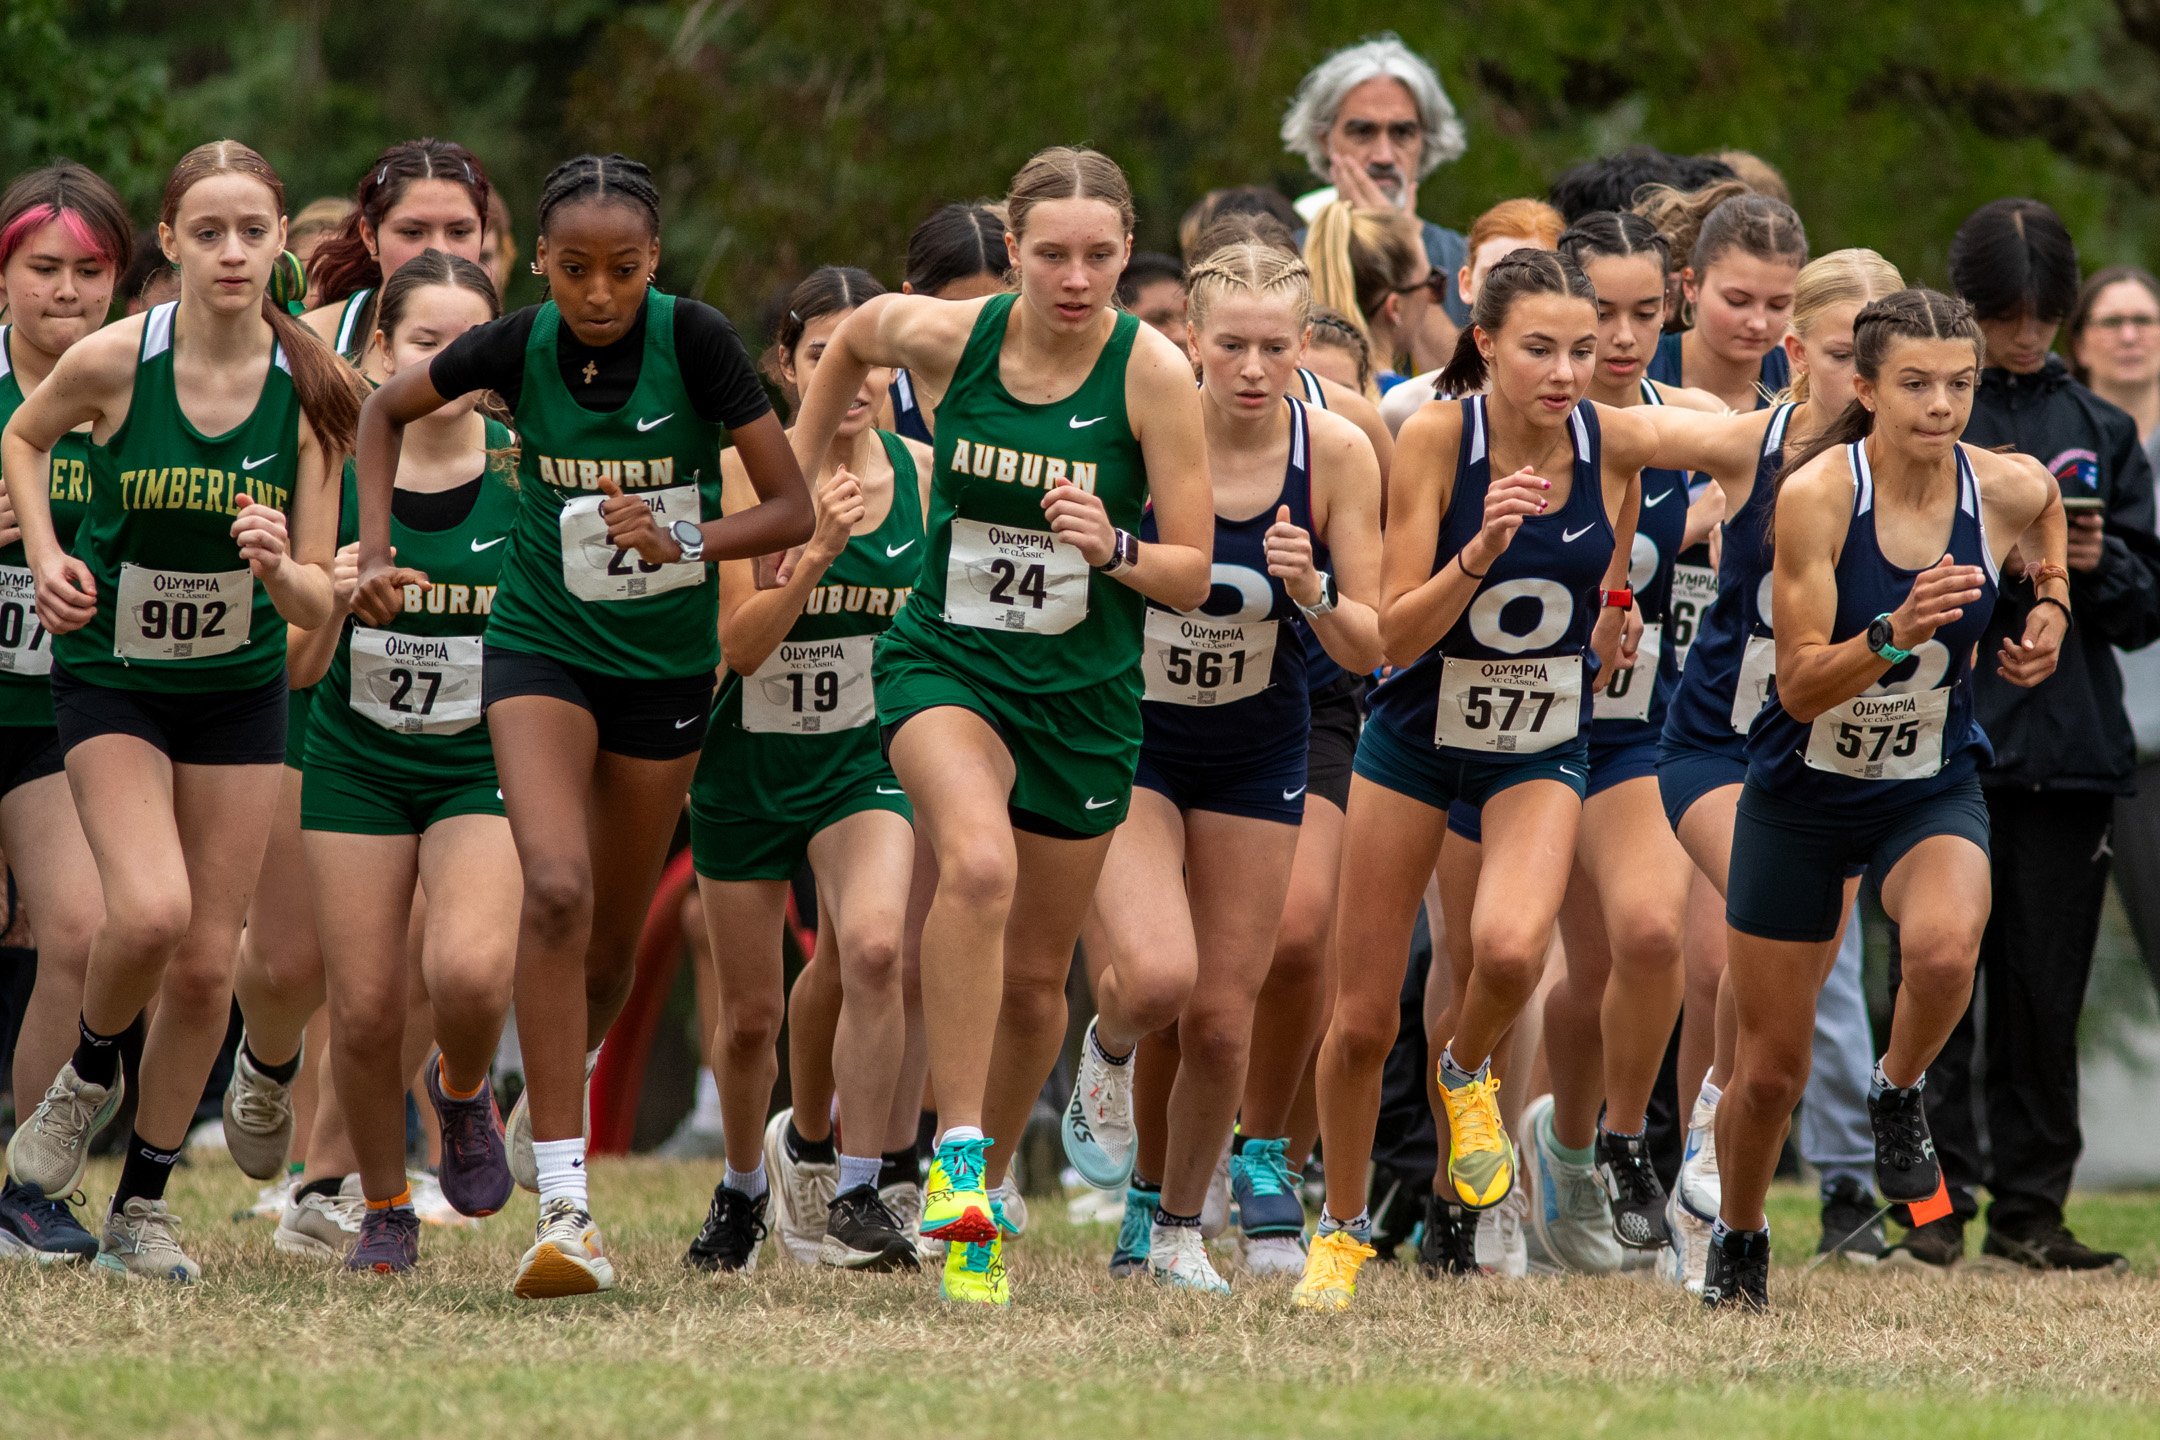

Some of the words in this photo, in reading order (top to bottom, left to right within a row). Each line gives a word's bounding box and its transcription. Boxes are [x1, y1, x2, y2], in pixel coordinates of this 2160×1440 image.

[538, 455, 674, 491] AUBURN
[950, 438, 1098, 496] AUBURN
[50, 458, 92, 503] ER
[120, 467, 288, 517] TIMBERLINE
[988, 527, 1055, 553] OLYMPIA
[998, 547, 1010, 555] XC
[1011, 549, 1045, 559] CLASSIC
[153, 574, 220, 592] OLYMPIA
[989, 558, 1047, 609] 24
[800, 584, 913, 616] UBURN
[141, 600, 227, 640] 902
[1181, 621, 1245, 641] OLYMPIA
[385, 636, 449, 661] OLYMPIA
[780, 643, 844, 663] OLYMPIA
[1190, 639, 1201, 647] XC
[1202, 641, 1235, 649] CLASSIC
[394, 658, 405, 666] XC
[406, 659, 440, 667] CLASSIC
[803, 661, 836, 669] CLASSIC
[1167, 645, 1246, 688] 561
[1481, 663, 1548, 682] OLYMPIA
[389, 668, 442, 715] 27
[786, 671, 838, 713] 19
[1504, 678, 1538, 687] CLASSIC
[1465, 686, 1555, 733] 577
[1852, 697, 1916, 717] OLYMPIA
[1874, 714, 1907, 723] CLASSIC
[1836, 720, 1920, 762] 575
